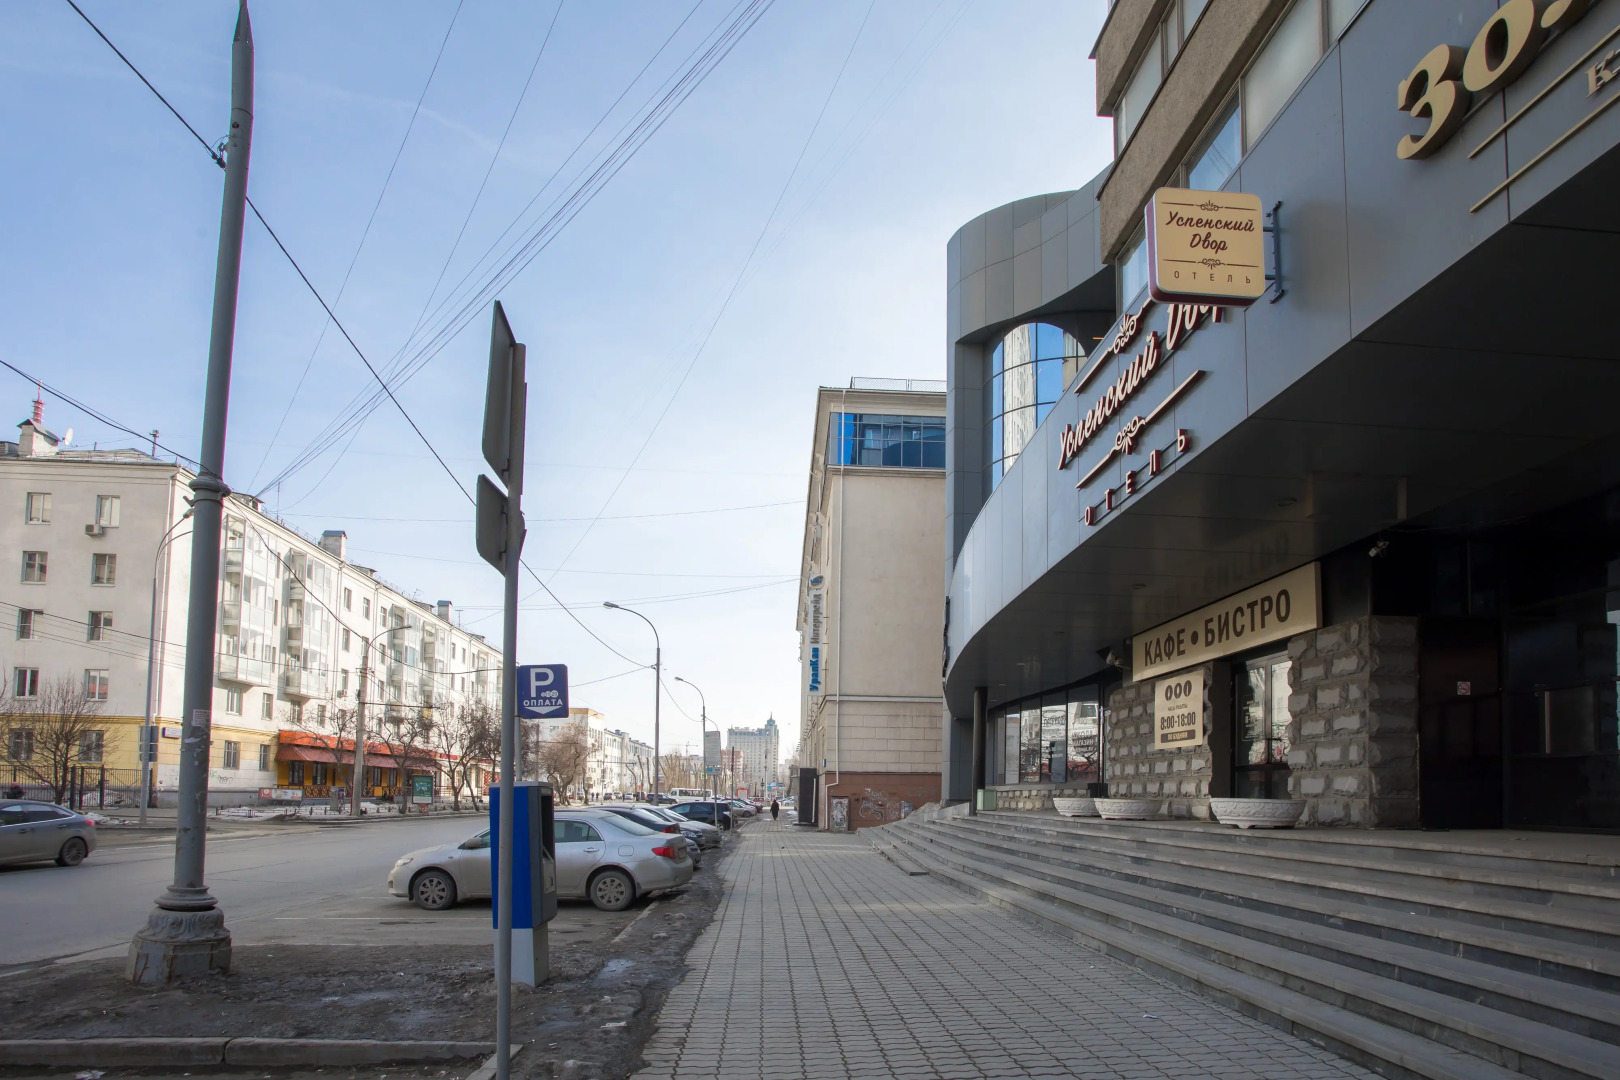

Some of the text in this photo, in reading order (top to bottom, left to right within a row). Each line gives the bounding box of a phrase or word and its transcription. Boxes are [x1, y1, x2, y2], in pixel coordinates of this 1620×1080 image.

[1165, 211, 1254, 232] Успенский
[1190, 232, 1228, 254] Двор
[1174, 271, 1251, 284] ОТЕЛЬ
[1058, 331, 1160, 470] Успенский
[1084, 429, 1191, 526] ОТЕЛЬ
[1144, 589, 1291, 666] КАФЕ БИСТРО
[530, 667, 554, 698] P
[1161, 712, 1195, 730] 8:00-18:00
